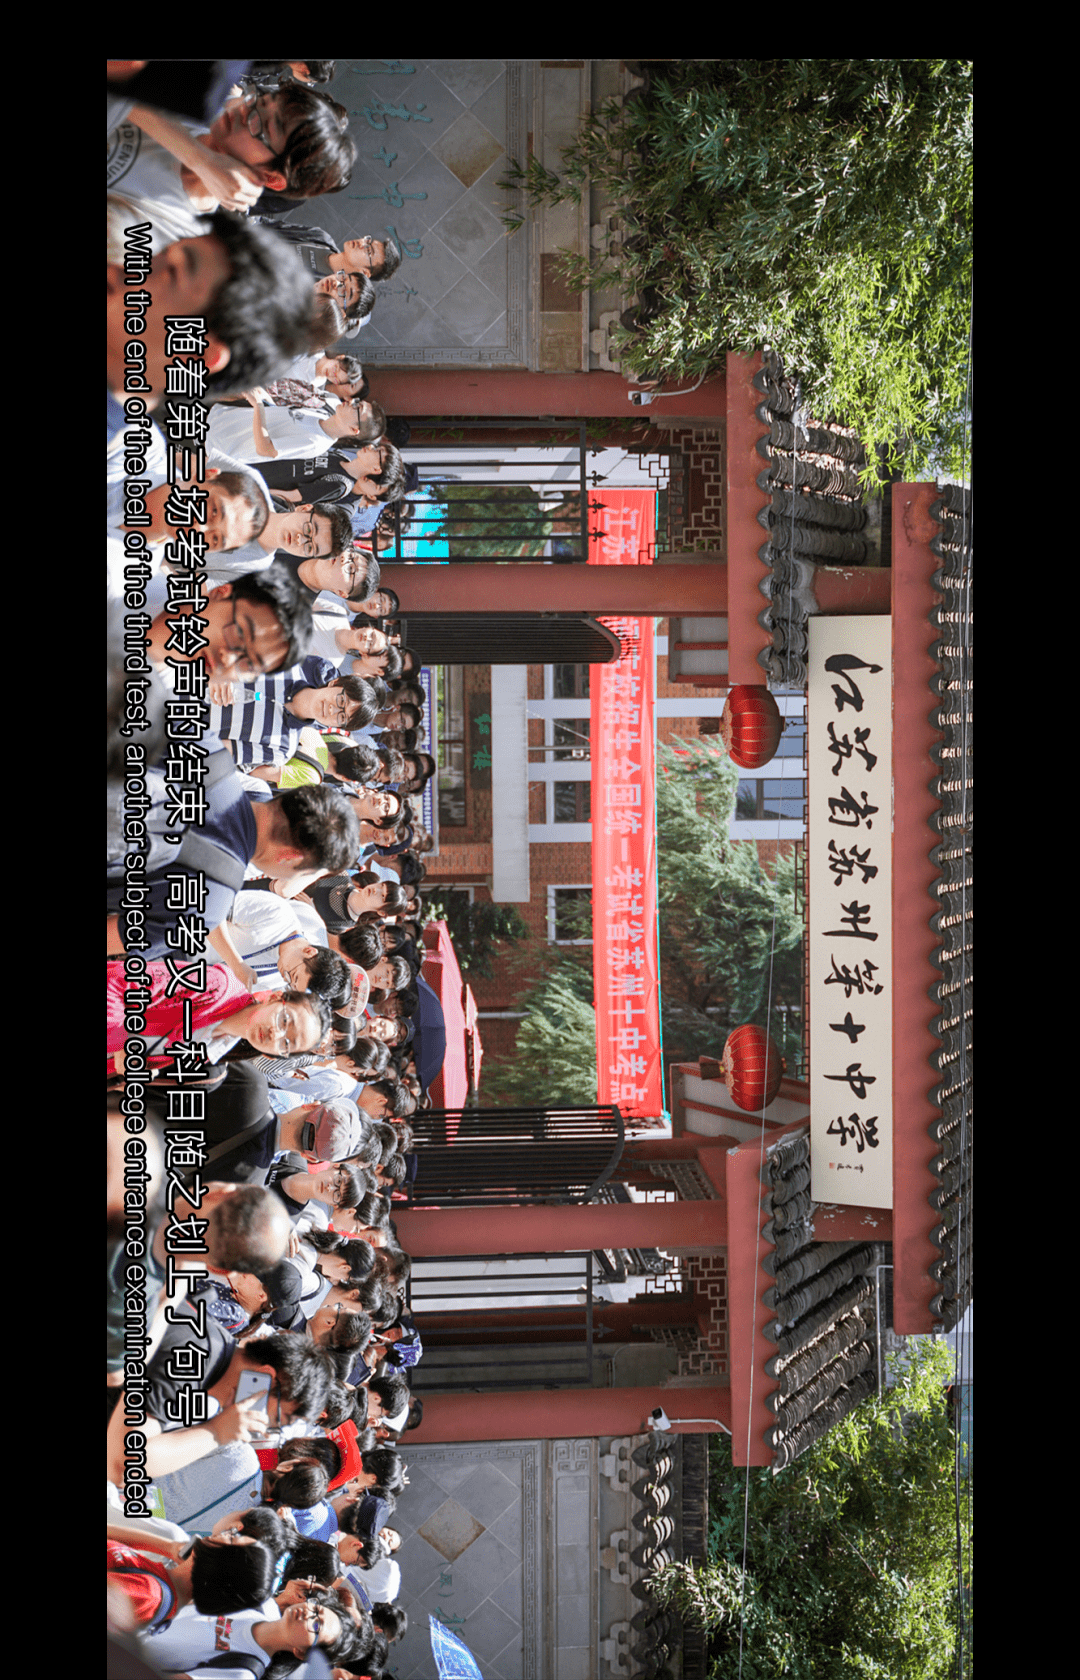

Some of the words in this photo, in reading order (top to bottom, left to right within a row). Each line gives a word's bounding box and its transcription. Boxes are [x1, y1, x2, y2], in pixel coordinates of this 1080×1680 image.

[309, 250, 317, 270] ATHLETE
[822, 653, 884, 1154] 江苏省苏州第十中学
